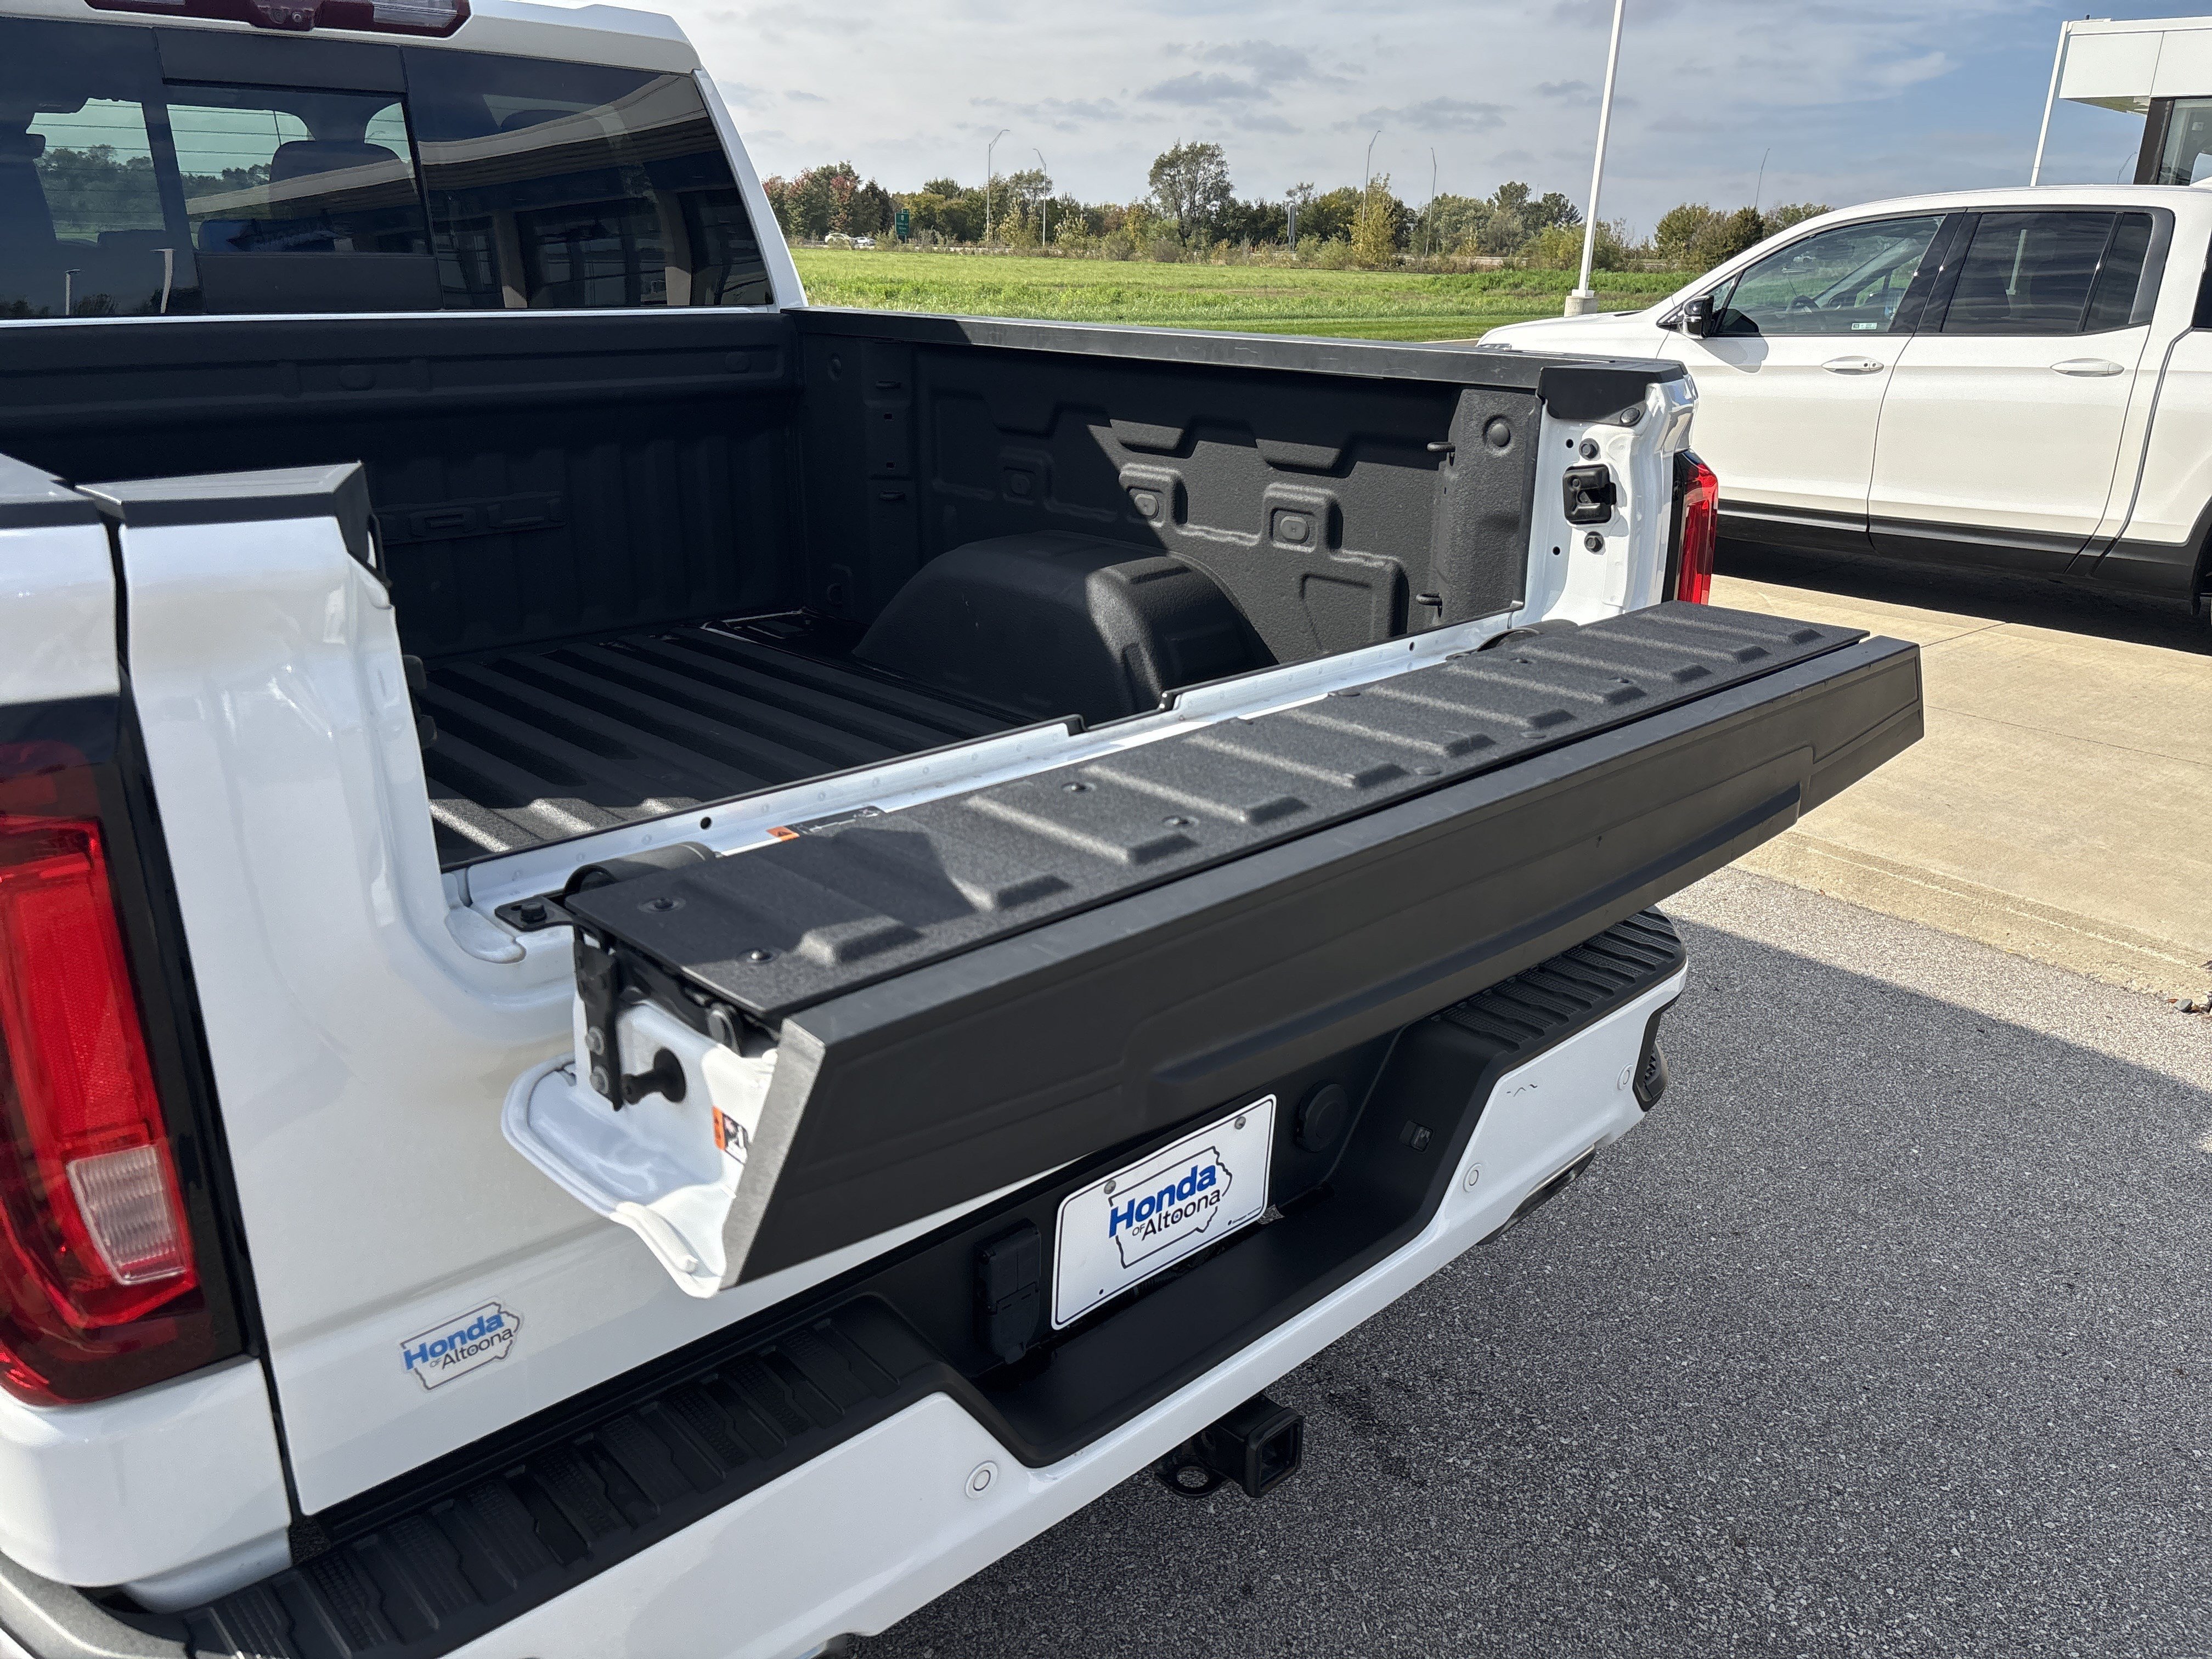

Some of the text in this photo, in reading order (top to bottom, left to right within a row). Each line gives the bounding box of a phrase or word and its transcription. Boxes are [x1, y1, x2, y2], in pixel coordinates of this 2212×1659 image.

[1109, 1165, 1216, 1238] Honda
[1132, 1223, 1145, 1237] OF
[1142, 1189, 1220, 1241] Altoona
[403, 1314, 504, 1370] Honda
[430, 1328, 514, 1369] OF Altoona
